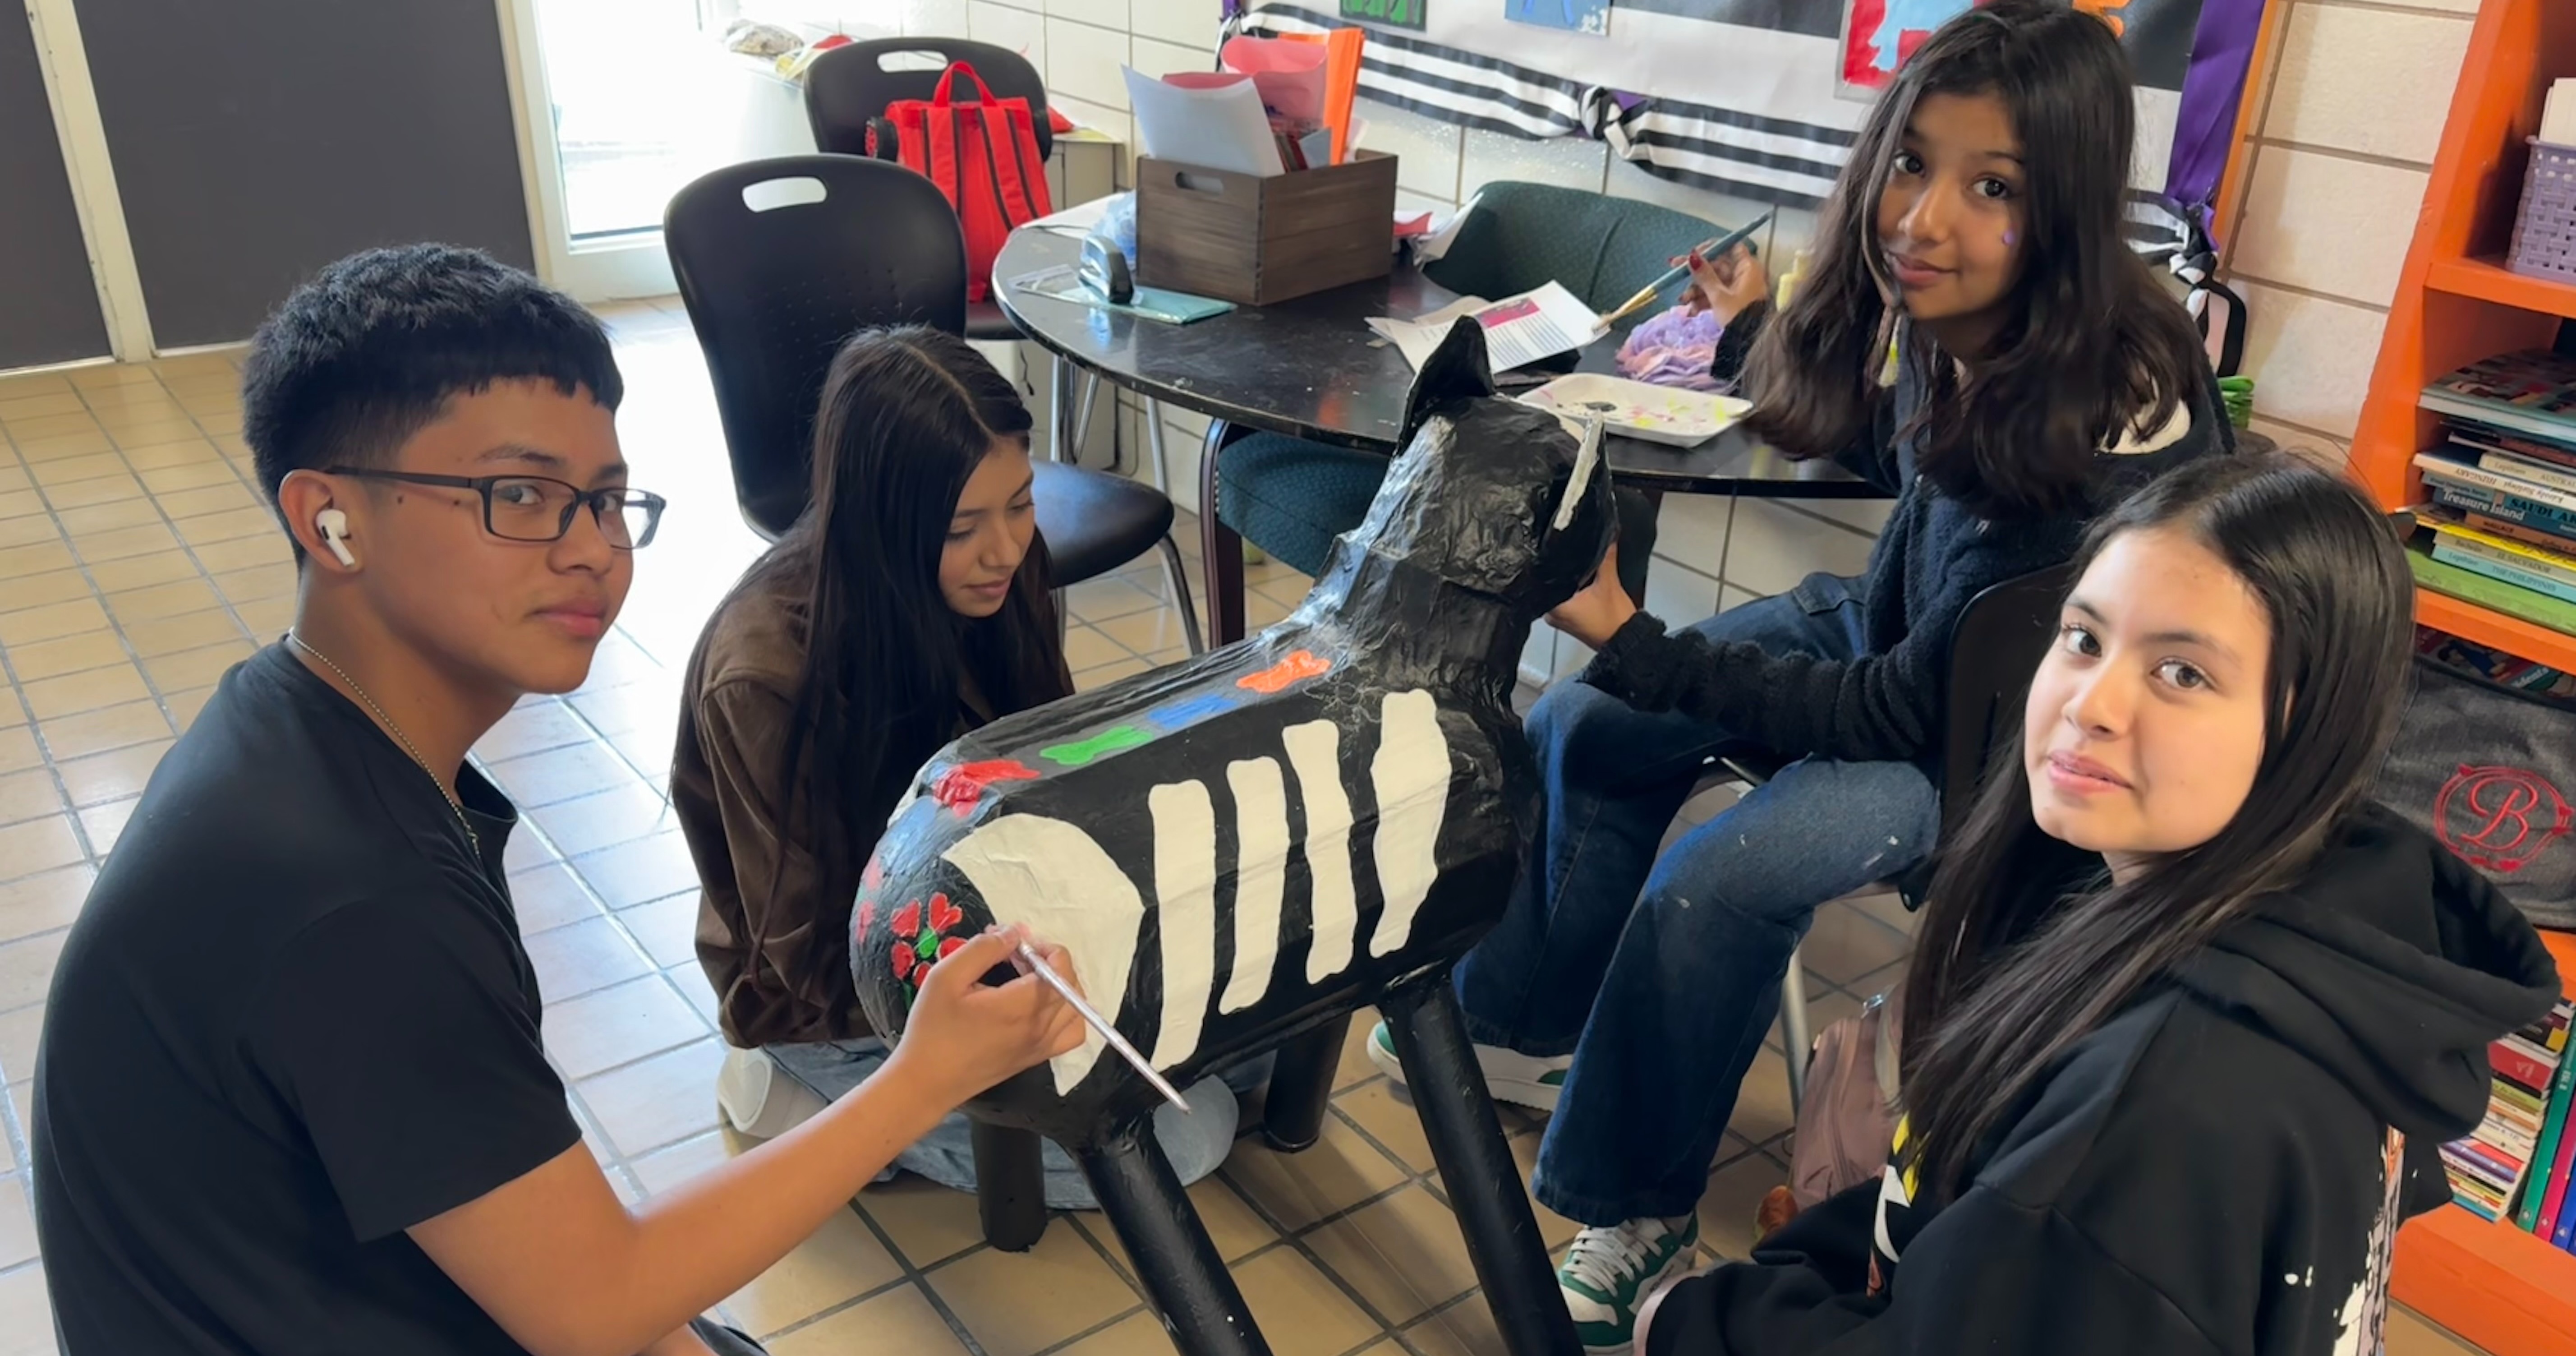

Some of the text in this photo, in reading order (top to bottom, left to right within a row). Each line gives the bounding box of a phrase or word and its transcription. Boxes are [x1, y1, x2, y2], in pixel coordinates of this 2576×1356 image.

[2456, 468, 2497, 485] HUNGARY
[2443, 488, 2525, 521] Treasure Island
[2512, 498, 2554, 517] SAUDI
[2507, 554, 2551, 573] SALVADOR
[2461, 776, 2538, 851] B
